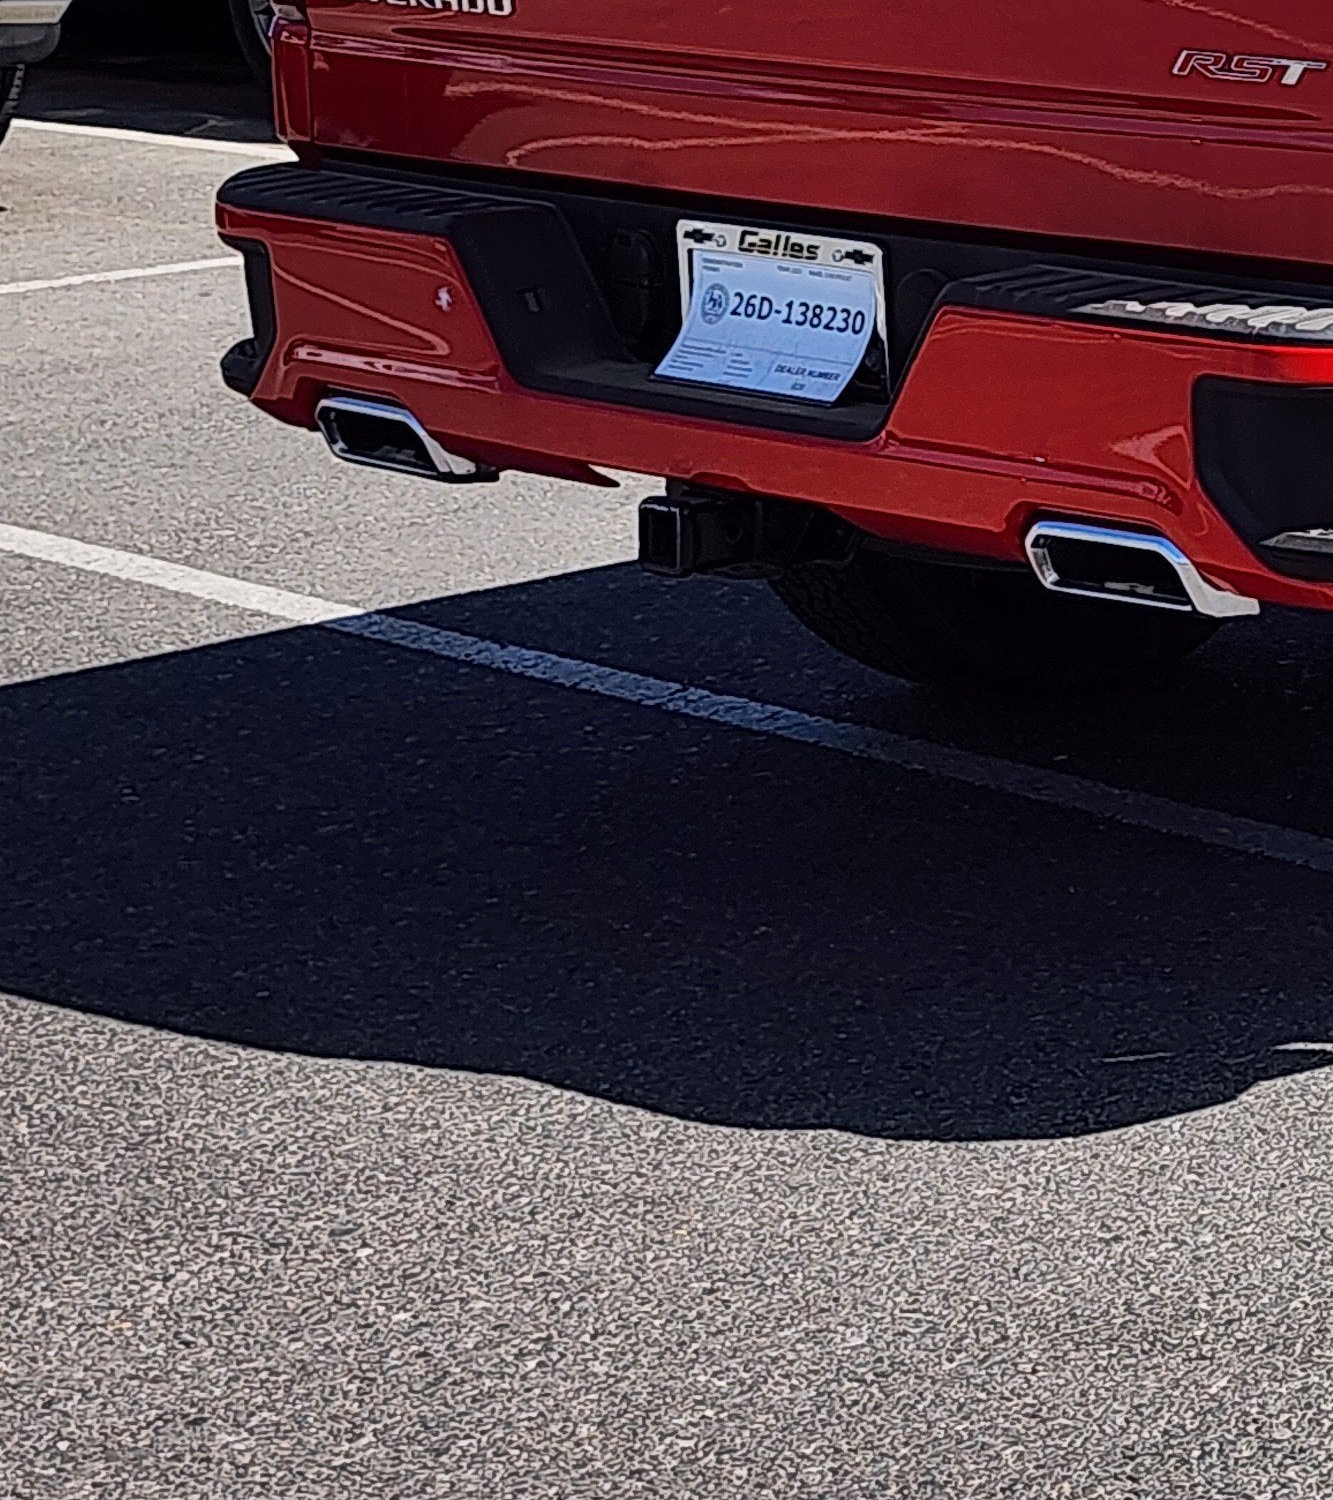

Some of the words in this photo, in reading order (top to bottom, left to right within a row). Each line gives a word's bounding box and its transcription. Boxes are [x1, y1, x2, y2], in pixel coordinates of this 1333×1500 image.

[1171, 49, 1328, 86] RST
[738, 229, 821, 261] Galles
[730, 291, 866, 336] 26D-138230
